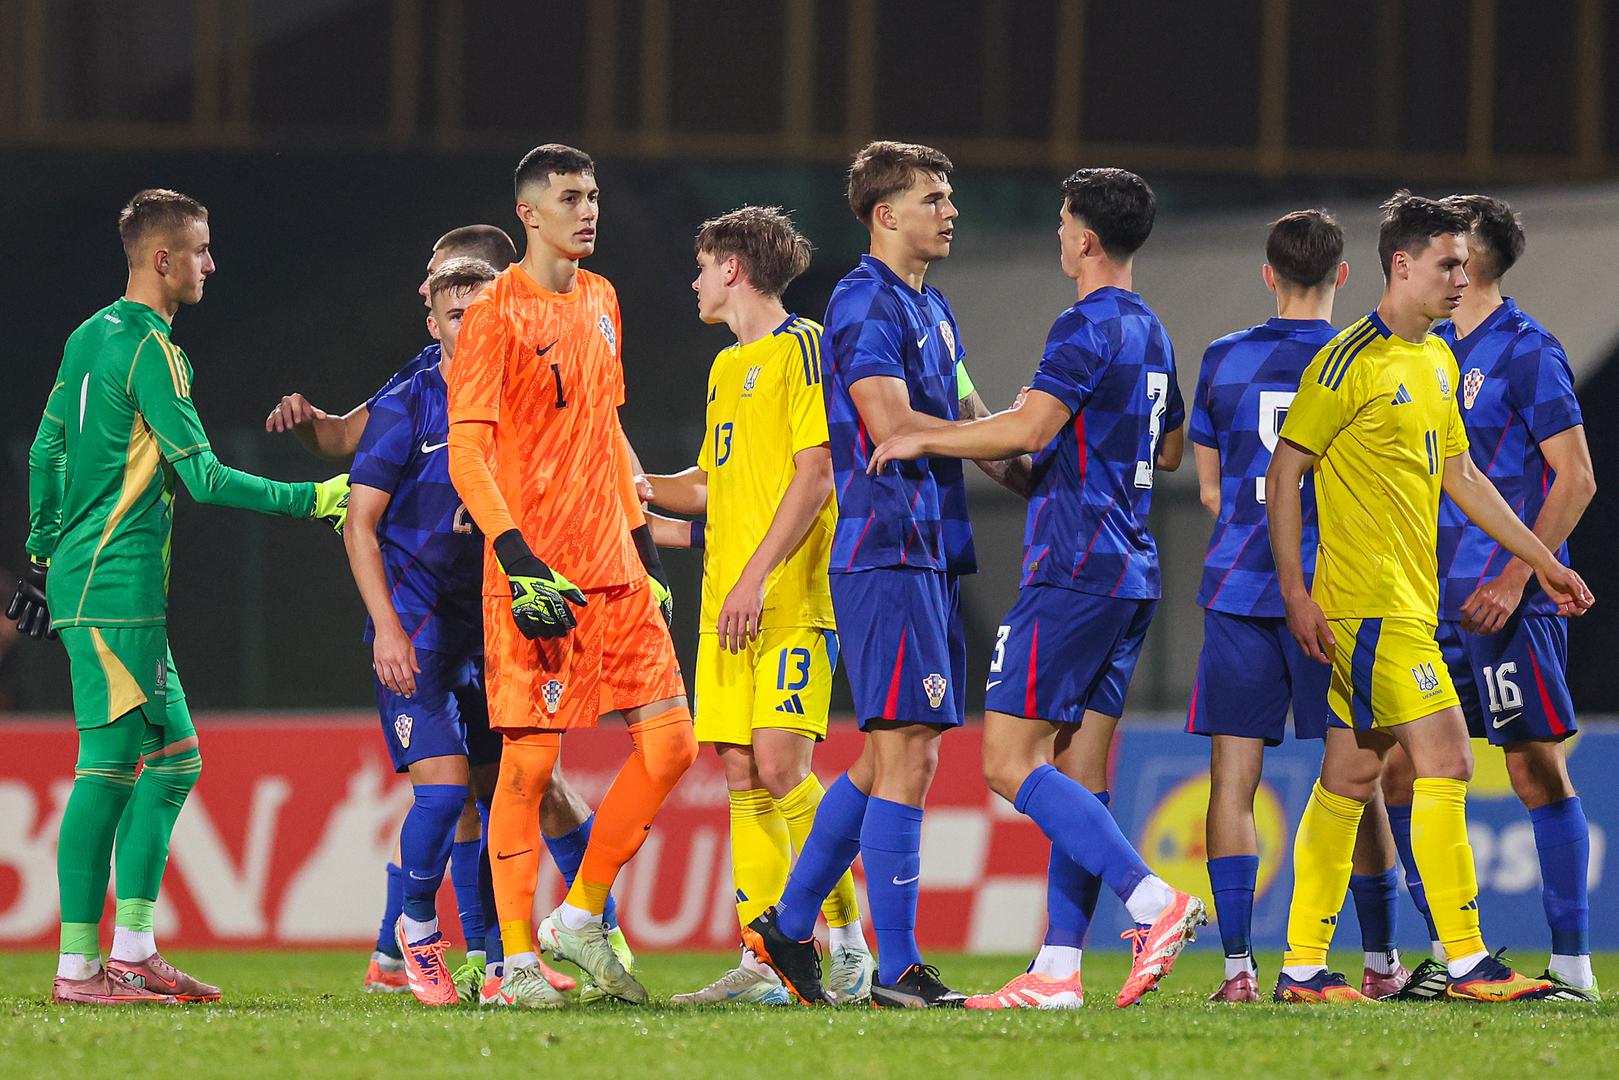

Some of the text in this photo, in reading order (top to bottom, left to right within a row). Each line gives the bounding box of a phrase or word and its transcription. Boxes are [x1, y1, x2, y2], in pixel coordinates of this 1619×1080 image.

[551, 363, 567, 409] 1
[714, 421, 734, 467] 13
[1134, 372, 1168, 489] 3
[1425, 429, 1439, 475] 11
[776, 647, 811, 691] 13
[989, 625, 1011, 673] 3
[1482, 661, 1524, 714] 16
